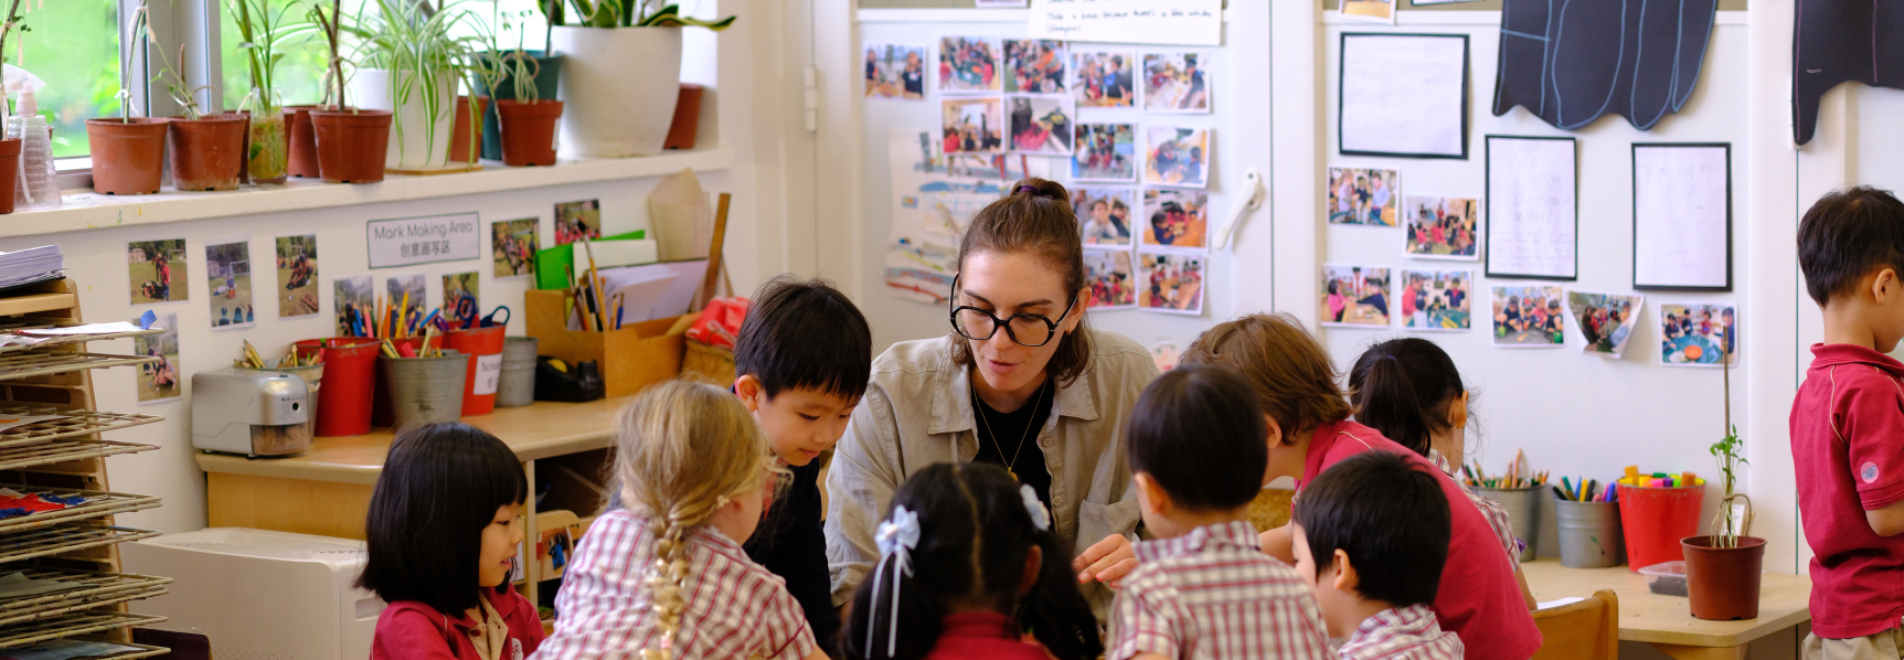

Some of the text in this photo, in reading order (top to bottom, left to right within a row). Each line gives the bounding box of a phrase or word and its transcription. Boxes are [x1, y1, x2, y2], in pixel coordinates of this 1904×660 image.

[374, 220, 473, 240] Mark Making Area
